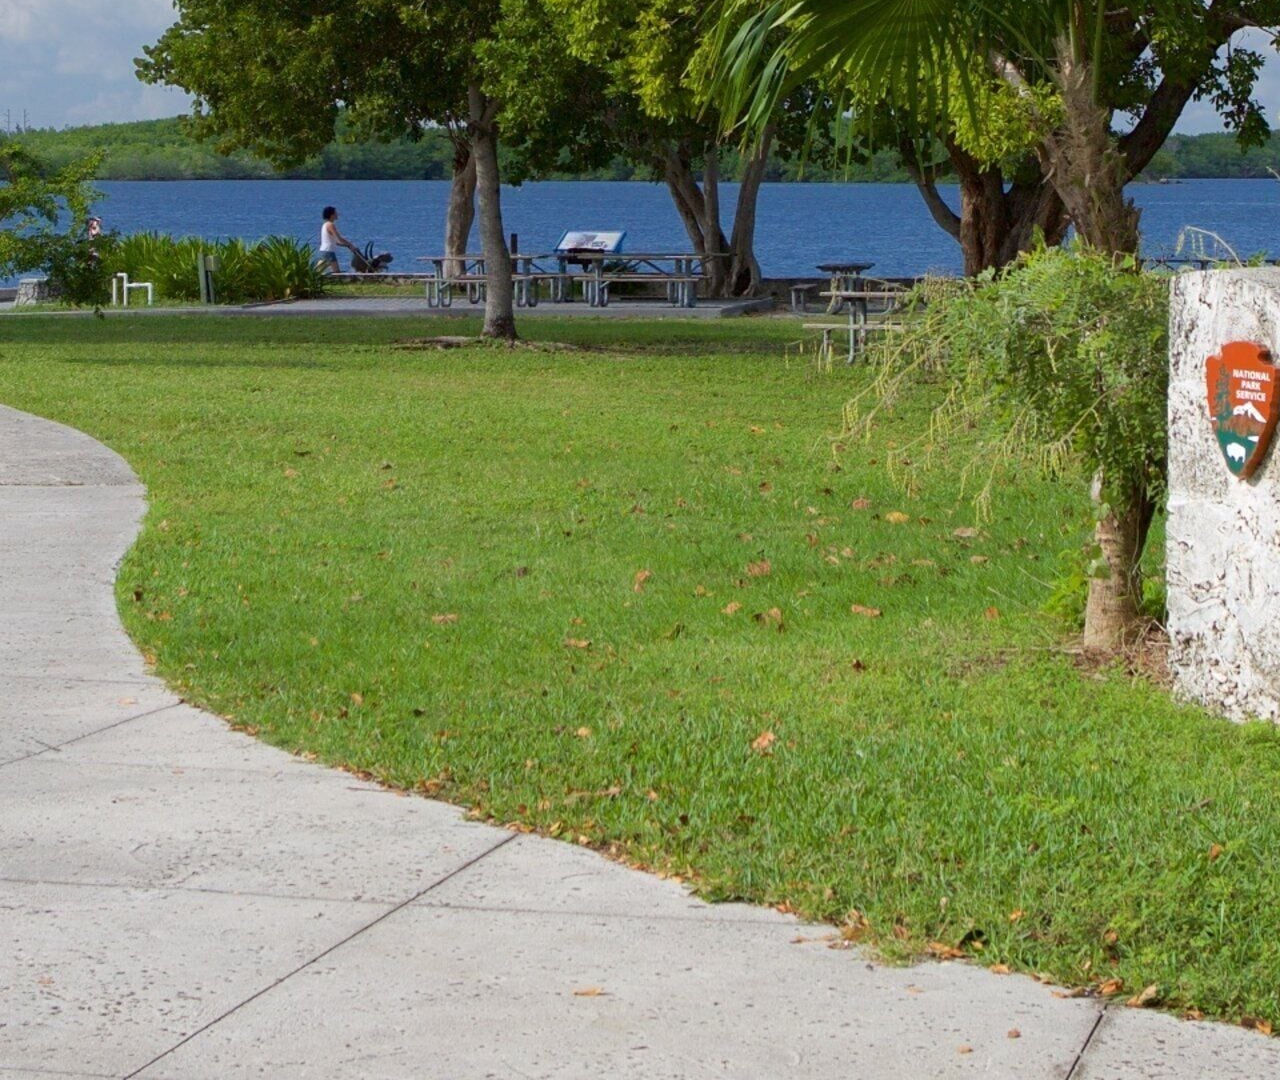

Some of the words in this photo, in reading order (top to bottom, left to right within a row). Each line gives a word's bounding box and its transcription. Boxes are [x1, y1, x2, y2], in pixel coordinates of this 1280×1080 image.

[1232, 369, 1271, 382] NATIONAL
[1240, 380, 1261, 391] PARK
[1236, 390, 1266, 402] SERVICE
